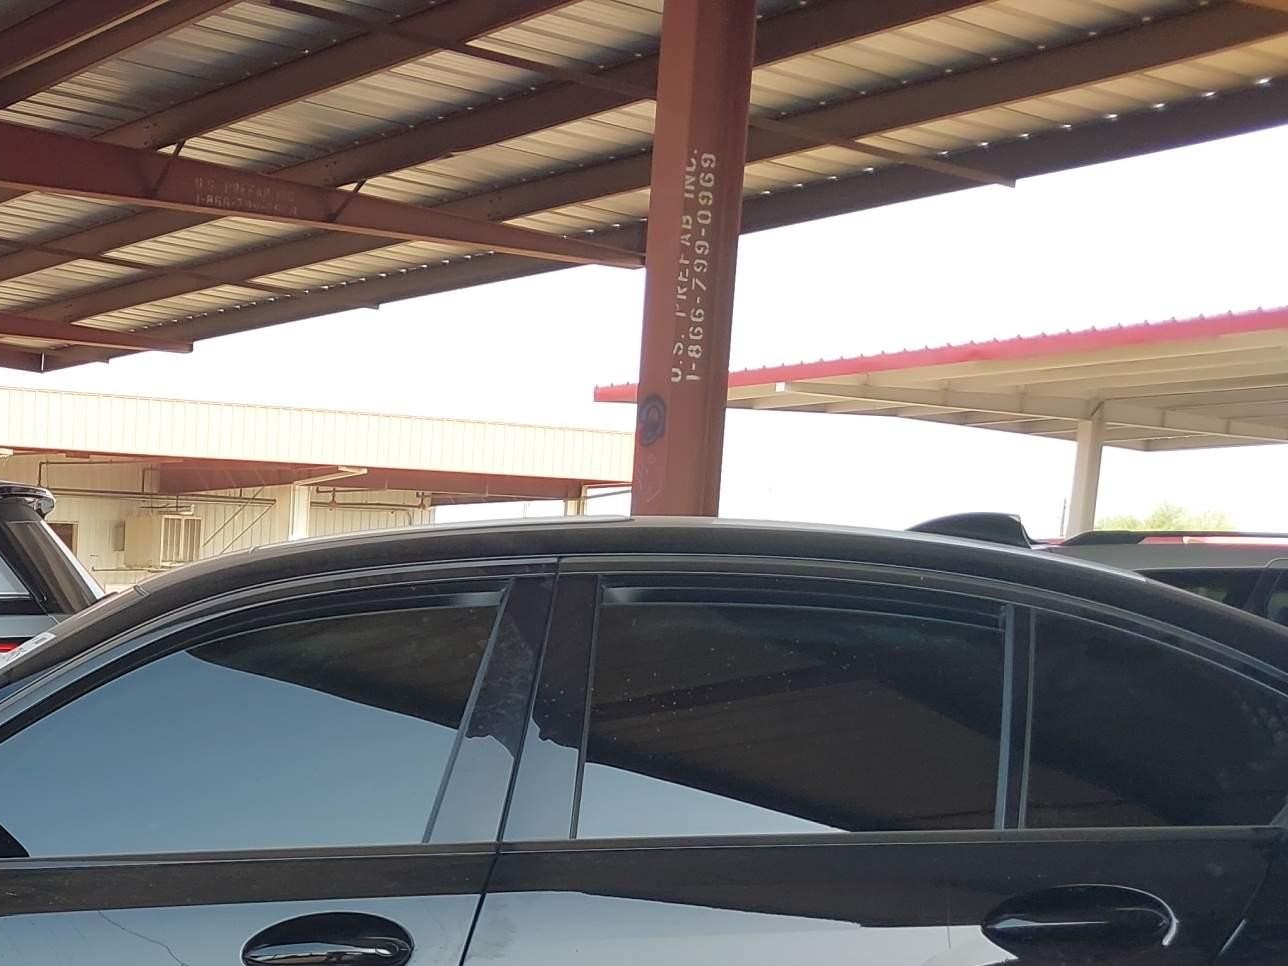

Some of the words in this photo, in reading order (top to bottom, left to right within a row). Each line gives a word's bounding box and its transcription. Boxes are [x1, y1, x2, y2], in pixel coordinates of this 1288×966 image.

[675, 215, 693, 317] PREFAB
[685, 152, 717, 382] 1-866-799-0969
[670, 335, 685, 382] U.S.
